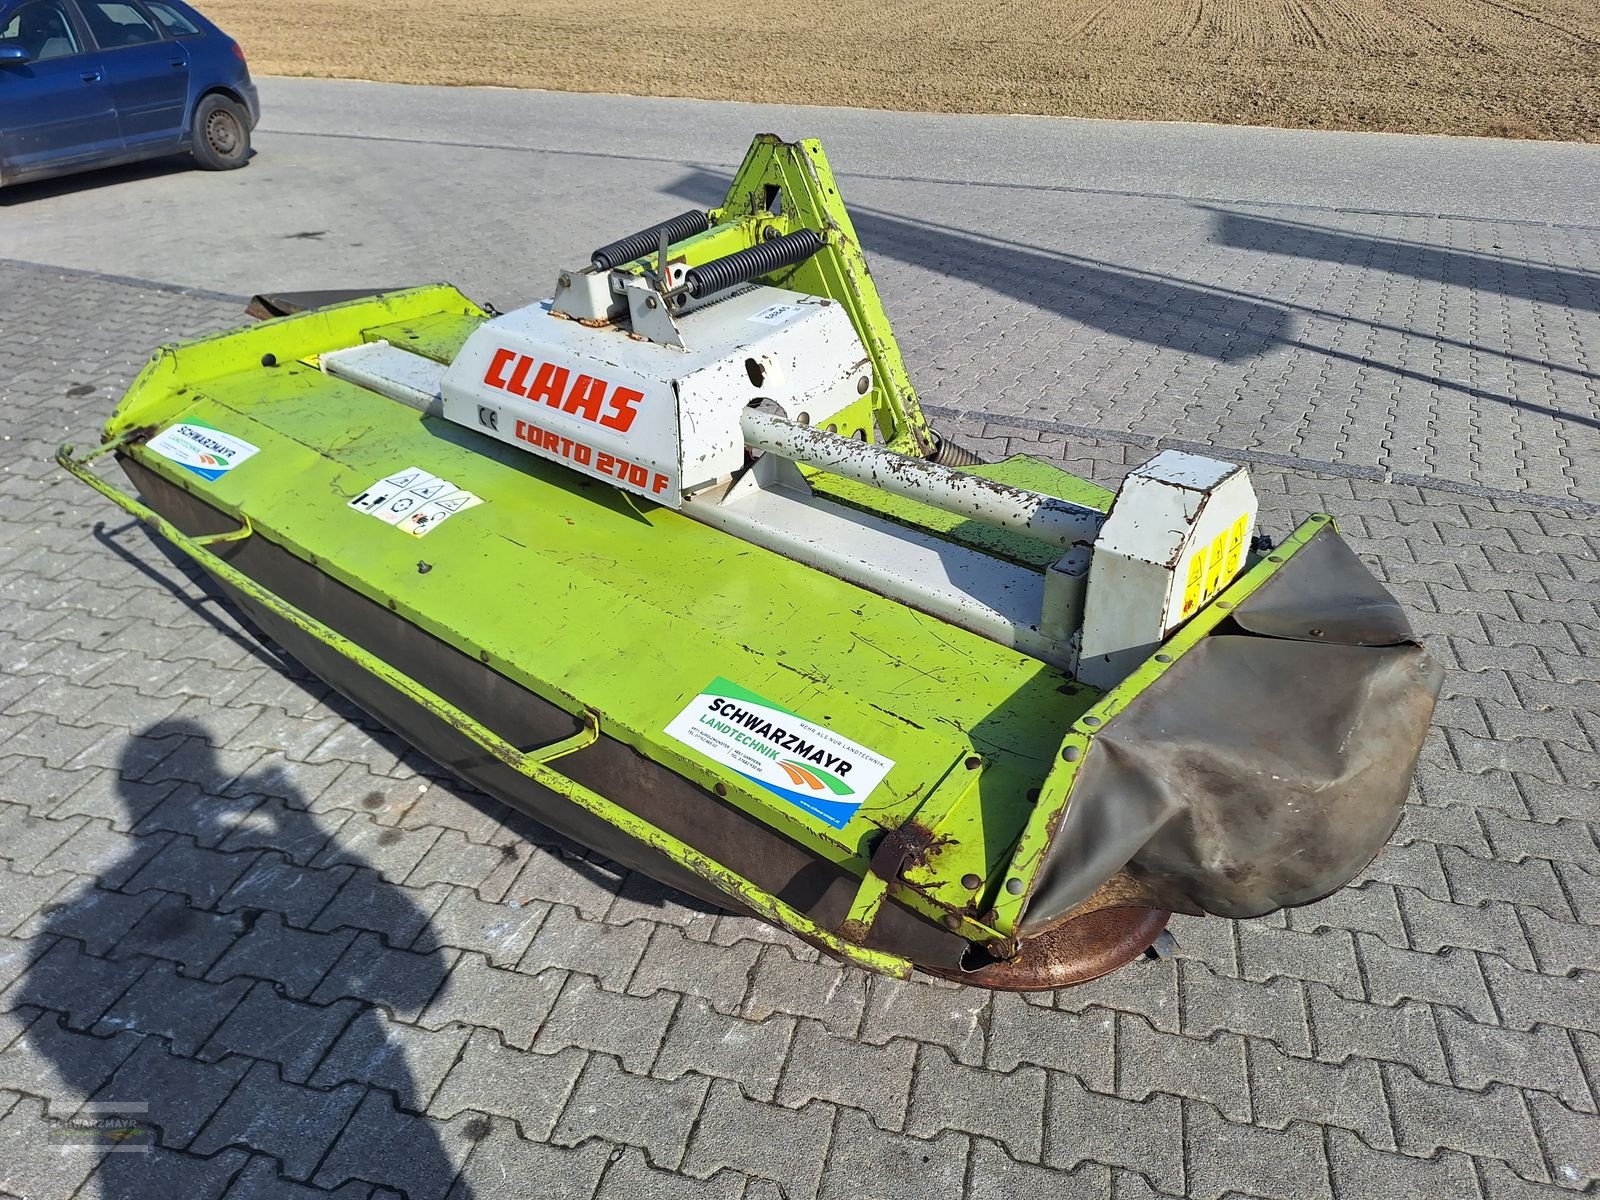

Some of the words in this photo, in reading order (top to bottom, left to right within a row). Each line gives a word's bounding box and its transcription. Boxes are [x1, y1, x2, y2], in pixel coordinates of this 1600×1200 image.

[484, 348, 645, 433] CLAAS
[177, 426, 236, 458] SCHWARZMAYR
[515, 420, 592, 466] CORTO
[596, 451, 648, 488] 270
[652, 473, 669, 494] F
[699, 714, 780, 760] LANDTECHNIK
[708, 698, 853, 777] SCHWARZMAYR
[800, 723, 815, 734] MEHR
[817, 731, 828, 740] ALS
[829, 737, 842, 747] NUR
